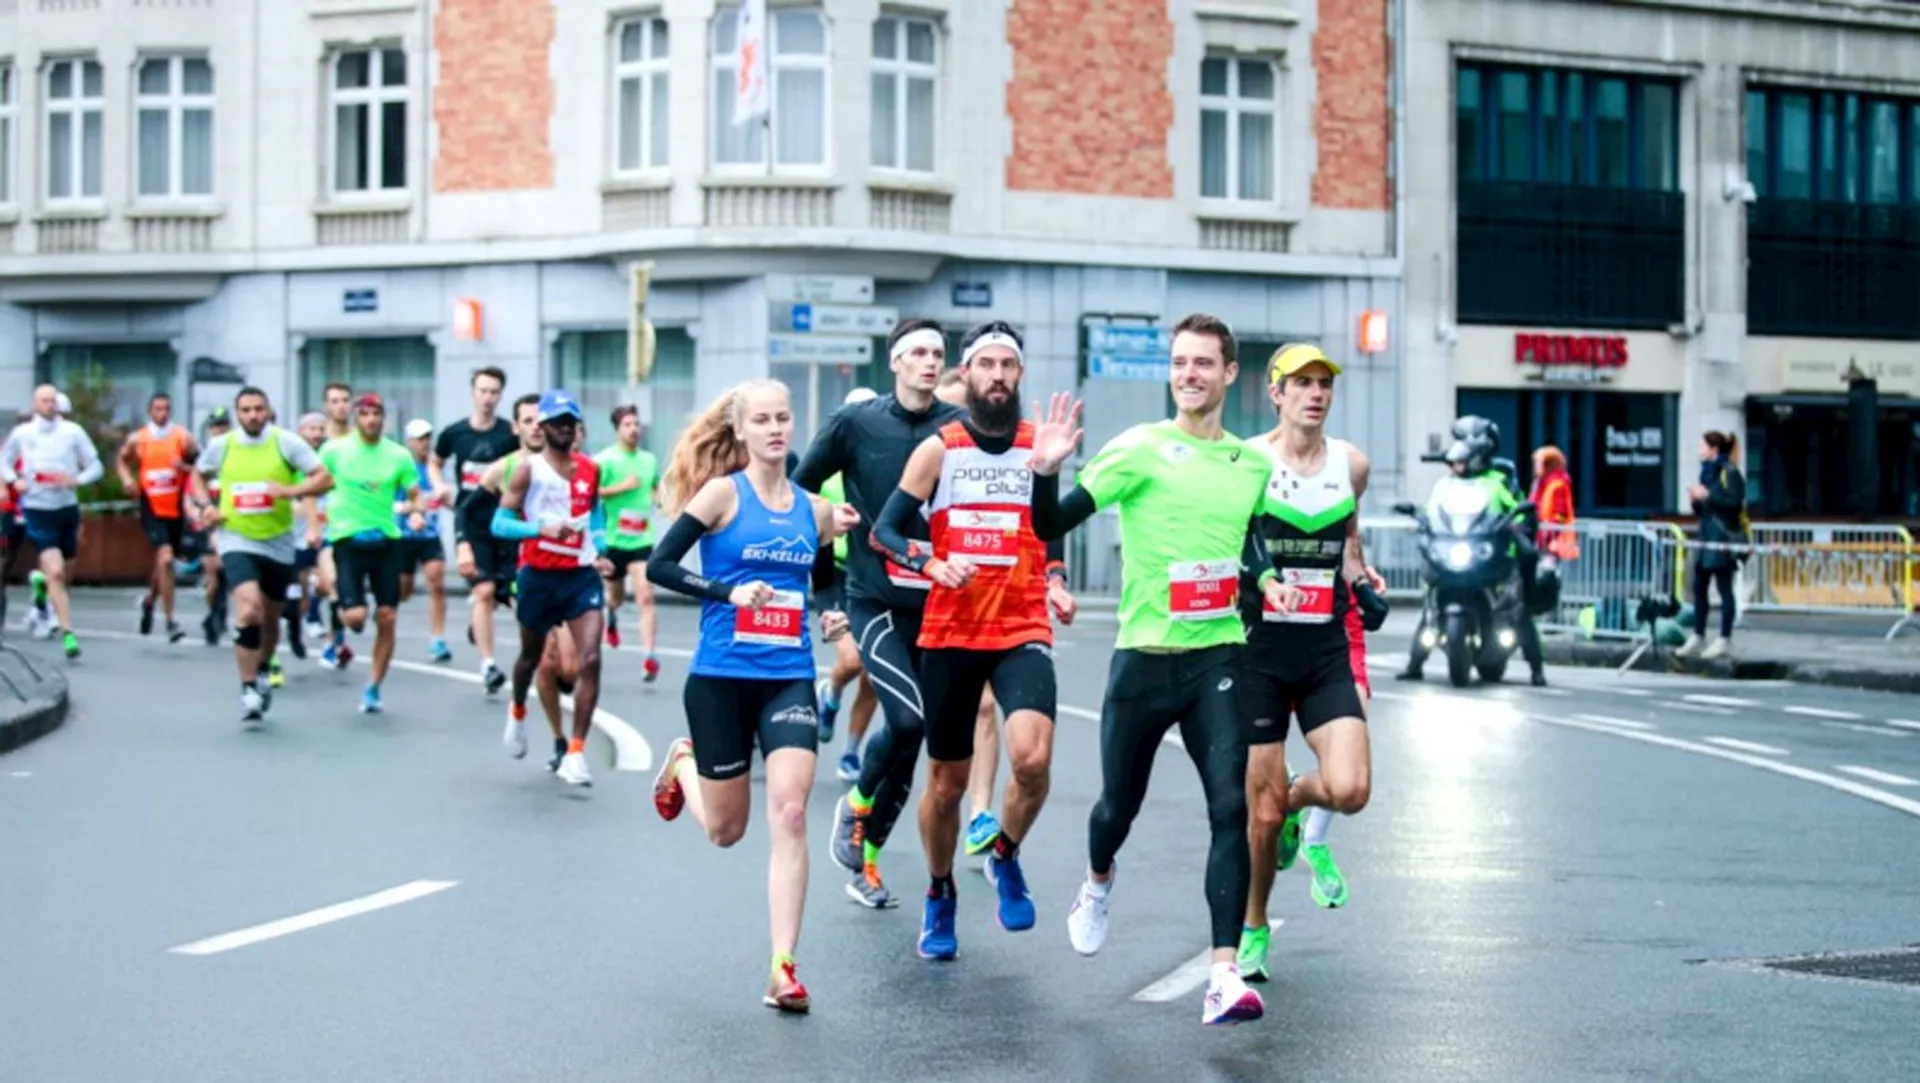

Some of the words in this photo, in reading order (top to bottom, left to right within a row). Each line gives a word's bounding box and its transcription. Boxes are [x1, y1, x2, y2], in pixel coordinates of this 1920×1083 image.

[1515, 333, 1628, 368] PRIMUS
[985, 482, 1031, 497] plus
[963, 533, 1001, 549] 8475
[753, 610, 790, 628] 8433
